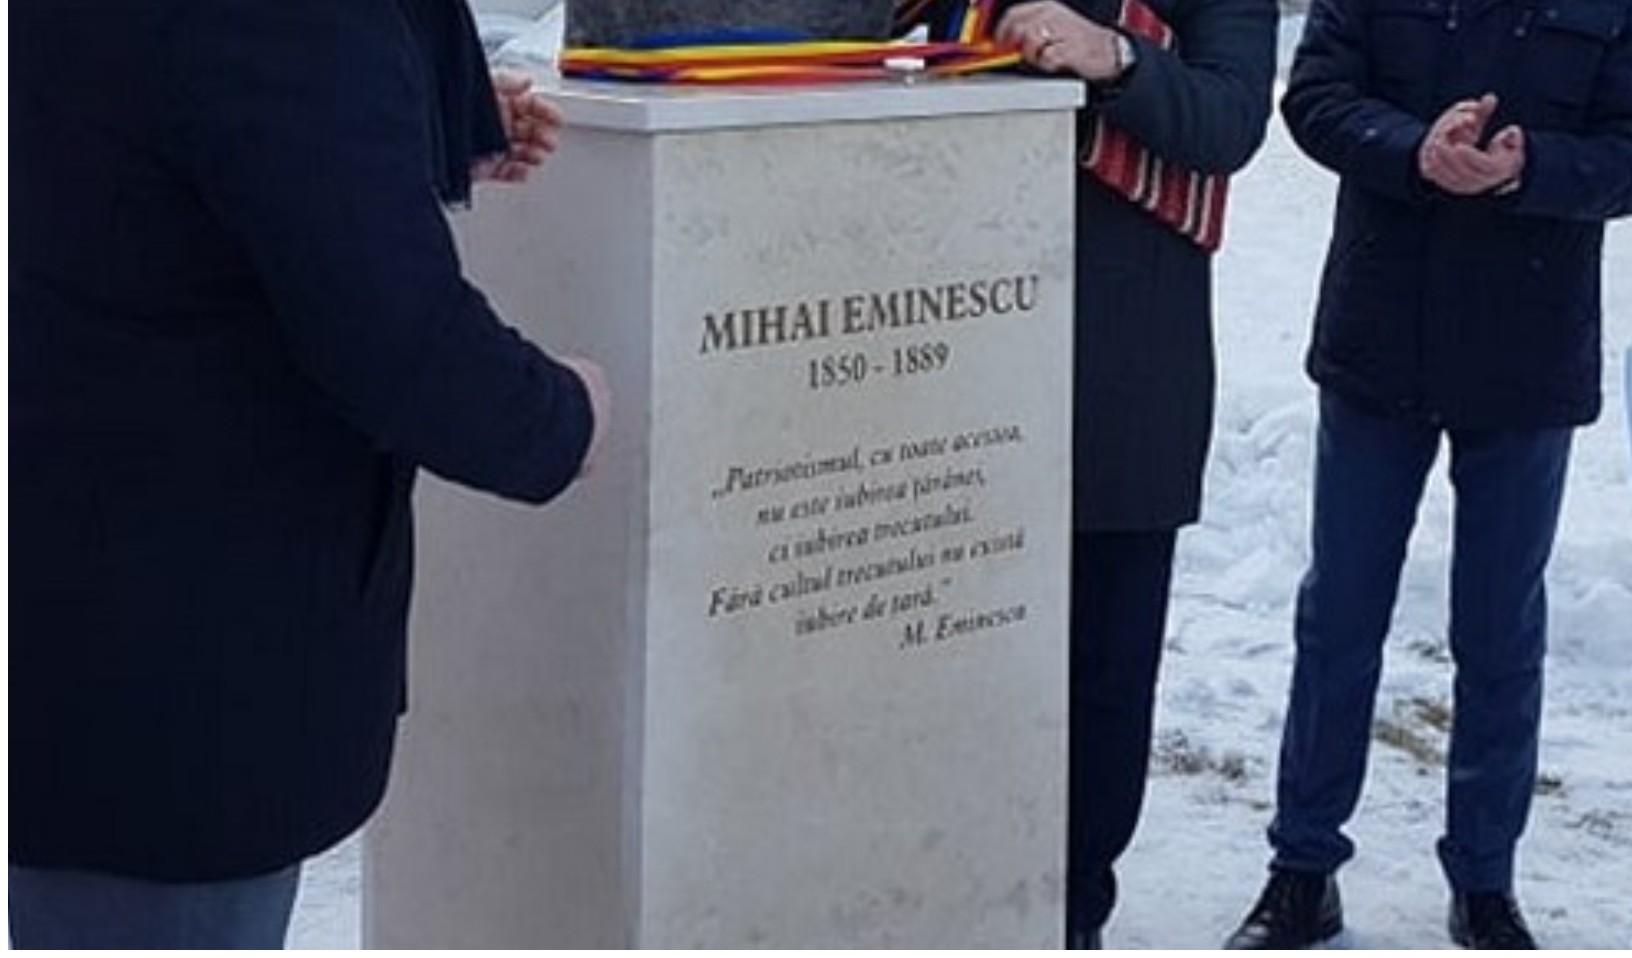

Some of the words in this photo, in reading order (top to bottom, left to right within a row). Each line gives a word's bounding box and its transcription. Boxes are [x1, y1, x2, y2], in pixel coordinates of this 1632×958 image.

[699, 299, 830, 354] MIHAI
[841, 275, 1040, 334] EMINESCU
[808, 353, 867, 390] 1850
[893, 341, 949, 377] 1889
[869, 449, 893, 466] cu
[756, 507, 785, 525] nu
[834, 480, 907, 510] iubirea
[795, 526, 869, 557] iubirea
[940, 545, 964, 564] nu
[862, 591, 887, 621] de
[899, 618, 927, 651] M.
[935, 604, 1027, 641] Eminescu
